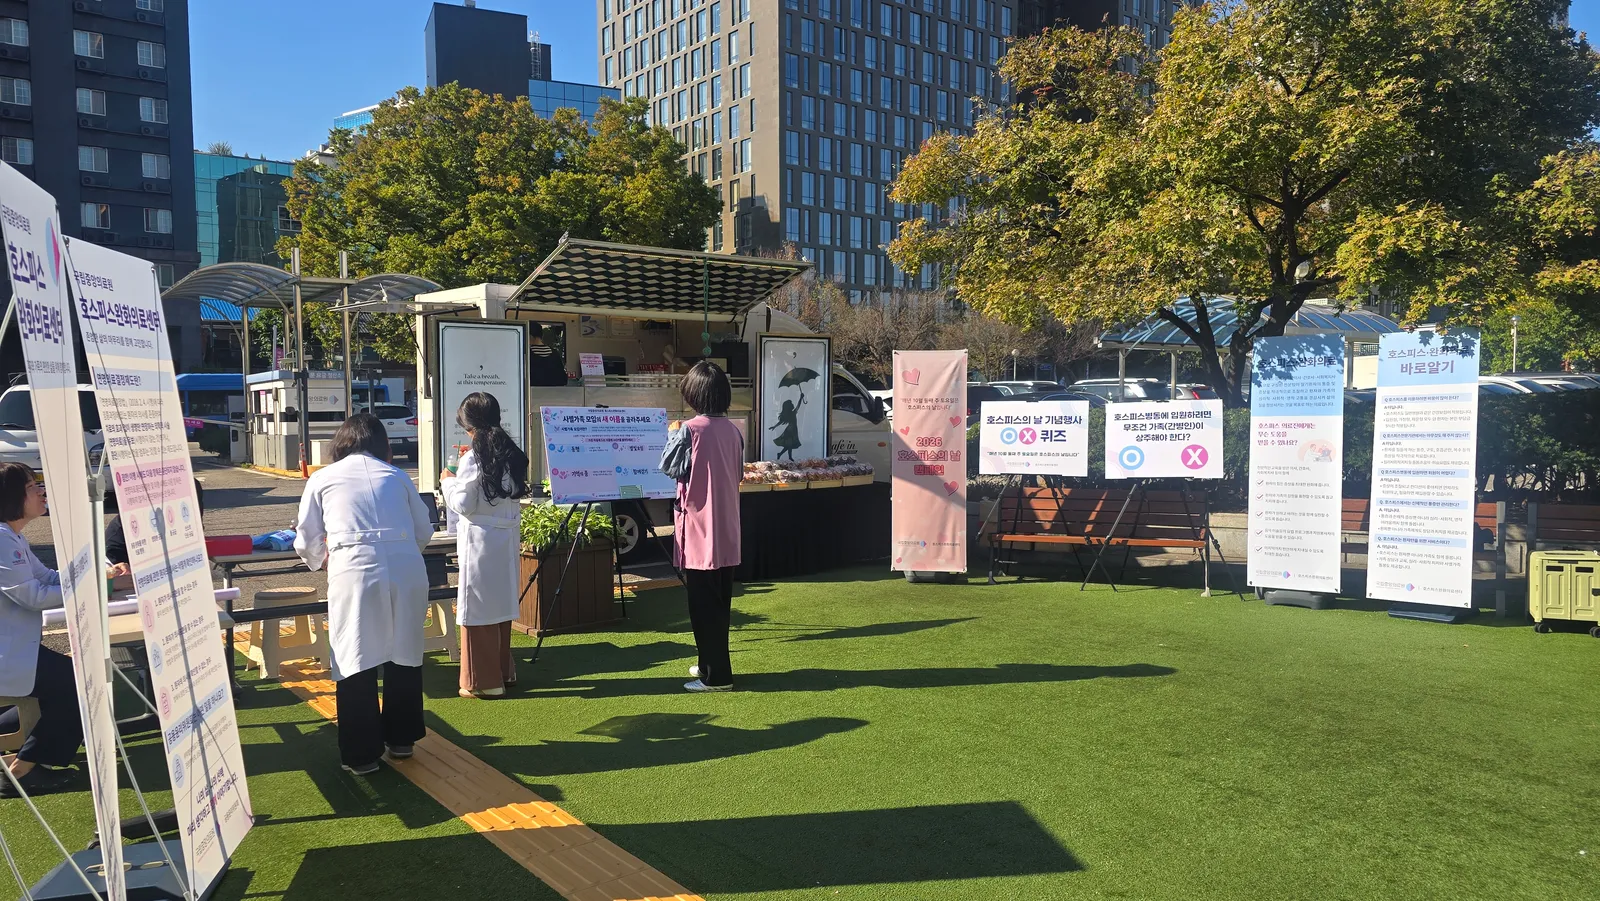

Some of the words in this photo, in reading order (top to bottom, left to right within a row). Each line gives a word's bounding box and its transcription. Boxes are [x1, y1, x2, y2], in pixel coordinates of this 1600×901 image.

[9, 241, 46, 291] 호스피스
[74, 269, 114, 292] 국립중앙의료원
[79, 296, 162, 333] 호스피스완화의료센터
[18, 297, 65, 345] 완화의료센터
[99, 334, 107, 344] 삶의
[108, 335, 124, 347] 마무리를
[125, 337, 133, 347] 함께
[1258, 356, 1337, 368] 호스피스·완화의료
[1400, 360, 1454, 375] 바로알기
[563, 415, 585, 423] 사별가족
[986, 415, 1031, 425] 호스피스의
[1033, 415, 1043, 425] 날
[1047, 414, 1082, 425] 기념행사
[1113, 412, 1169, 421] 호스피스병동에
[1171, 411, 1212, 419] 입원하려면
[1123, 423, 1147, 432] 무조건
[1148, 421, 1204, 431] 가족(간병인)이
[1040, 429, 1067, 443] 퀴즈
[1135, 433, 1168, 442] 상주해야
[1169, 433, 1191, 442] 한다?
[847, 441, 855, 450] in
[916, 437, 942, 447] 2026
[898, 450, 949, 461] 호스피스의
[950, 450, 961, 461] 날
[914, 464, 944, 475] 캠페인
